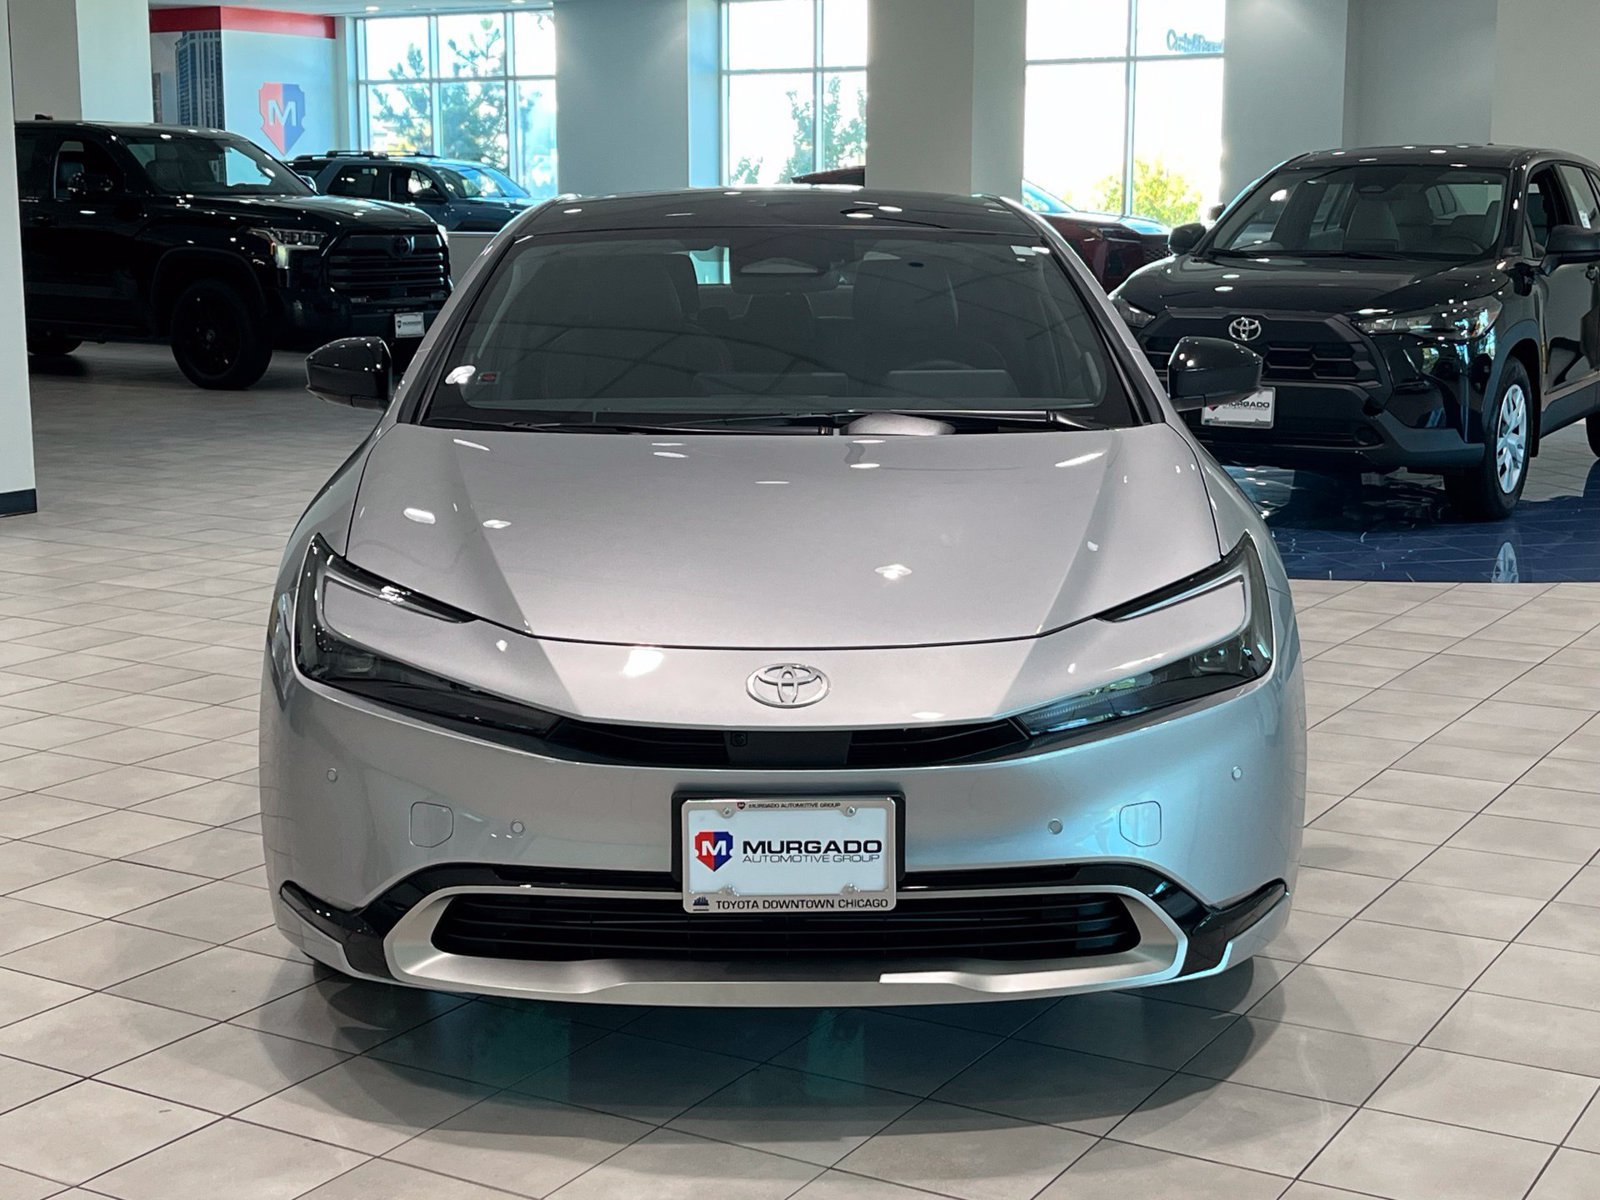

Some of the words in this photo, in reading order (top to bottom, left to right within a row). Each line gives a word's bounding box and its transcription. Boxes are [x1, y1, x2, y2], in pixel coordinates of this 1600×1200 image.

[268, 100, 297, 126] M
[701, 840, 727, 856] M
[742, 840, 882, 854] MURGADO
[742, 854, 830, 863] AUTOMOTIVE
[832, 854, 880, 863] GROUP
[716, 900, 759, 910] TOYOTA
[762, 899, 835, 909] DOWNTOWN
[837, 898, 888, 909] CHICAGO
